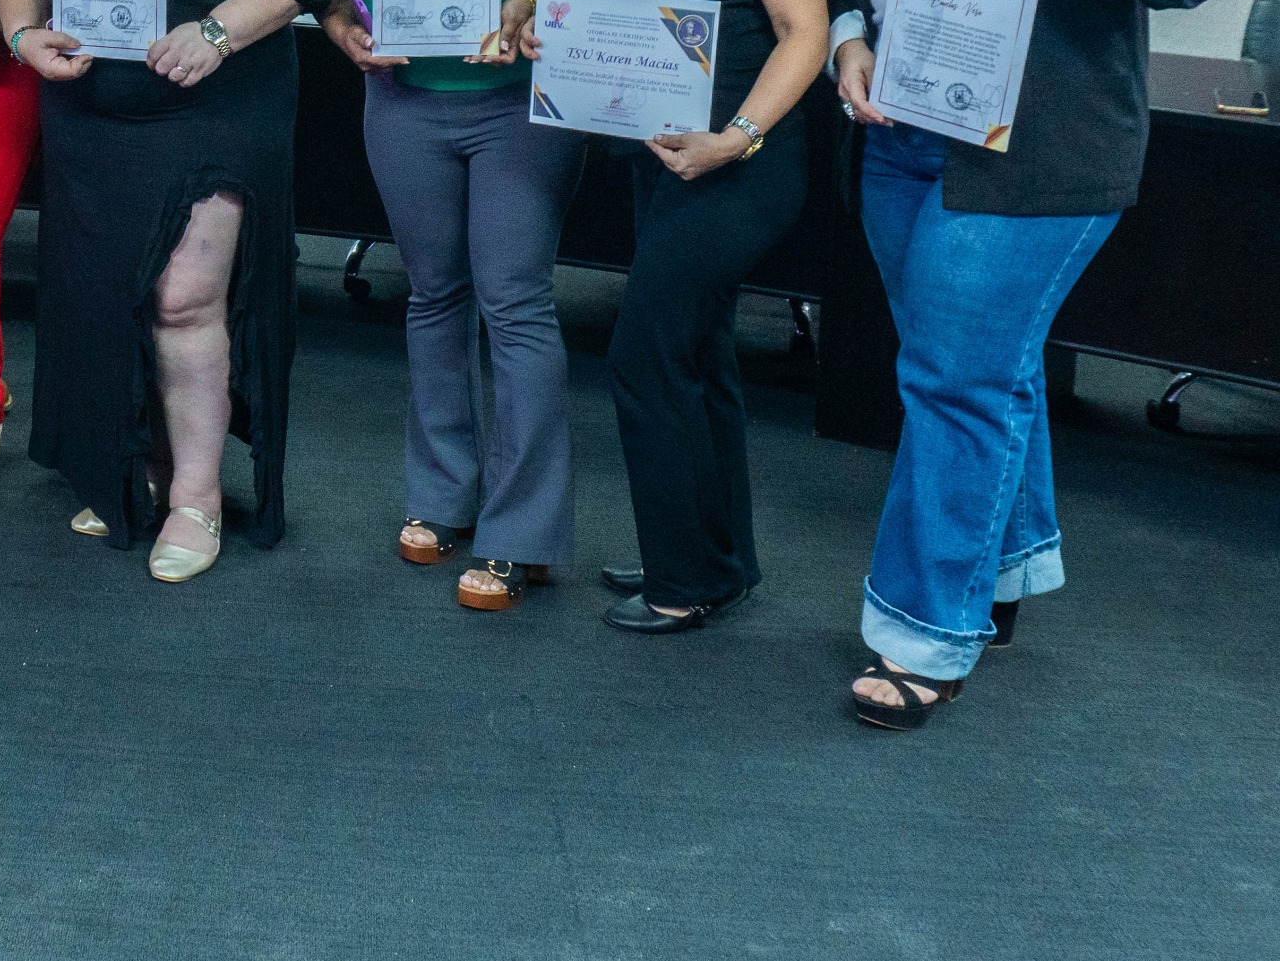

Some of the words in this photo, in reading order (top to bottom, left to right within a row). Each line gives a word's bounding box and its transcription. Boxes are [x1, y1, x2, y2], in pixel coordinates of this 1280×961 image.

[545, 20, 563, 29] UBV
[566, 47, 594, 60] TSU
[596, 51, 632, 65] Karen
[635, 56, 679, 70] Macias
